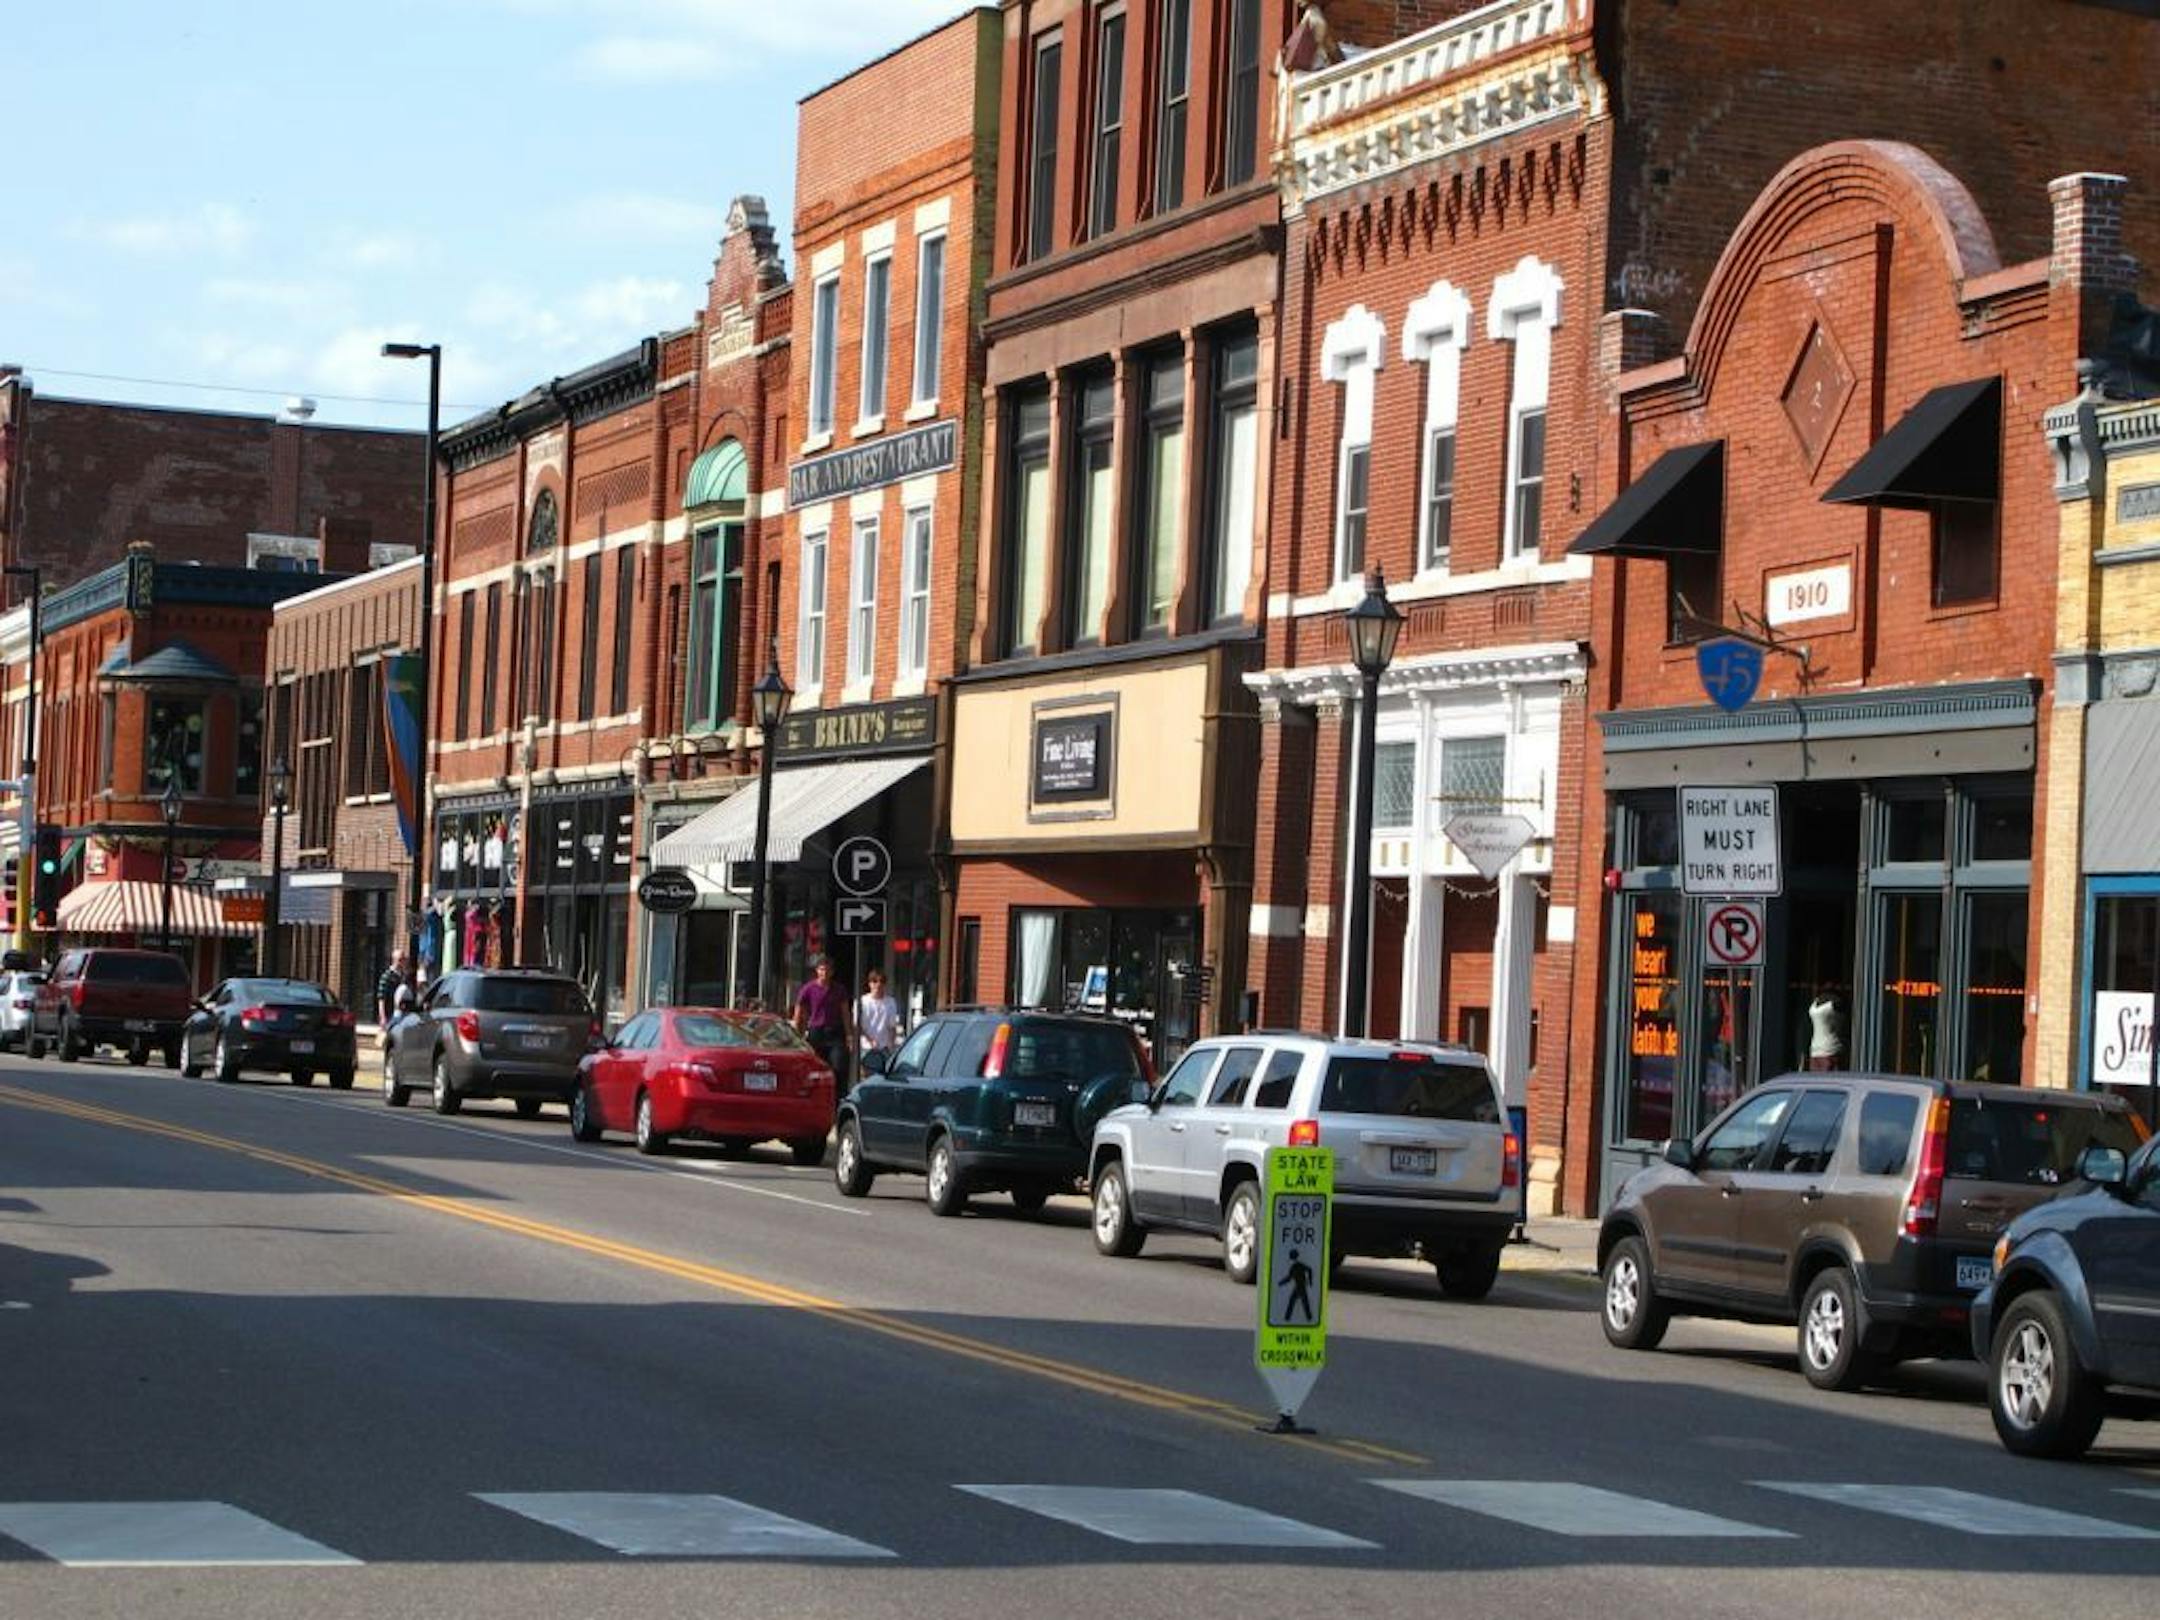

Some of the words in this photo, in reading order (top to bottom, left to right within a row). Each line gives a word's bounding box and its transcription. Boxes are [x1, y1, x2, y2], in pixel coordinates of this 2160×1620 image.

[792, 465, 819, 502] BAR
[822, 458, 851, 491] AND
[853, 427, 952, 484] RESTAURANT
[1787, 581, 1828, 610] 1910
[1704, 651, 1751, 694] 45
[814, 710, 886, 748] BRINE'S
[1687, 800, 1727, 816] RIGHT
[1735, 800, 1771, 817] LANE
[1704, 830, 1755, 850] MUST
[852, 851, 877, 881] P
[1688, 864, 1725, 880] TURN
[1734, 863, 1774, 880] RIGHT
[1636, 912, 1655, 937] we
[1635, 941, 1667, 975] heart
[1634, 986, 1663, 1019] your
[1278, 1156, 1326, 1169] STATE
[1284, 1174, 1318, 1187] LAW
[1278, 1202, 1322, 1218] STOP
[1282, 1227, 1316, 1244] FOR
[1276, 1333, 1311, 1345] WITHIN
[1260, 1350, 1323, 1363] CROSSWALK
